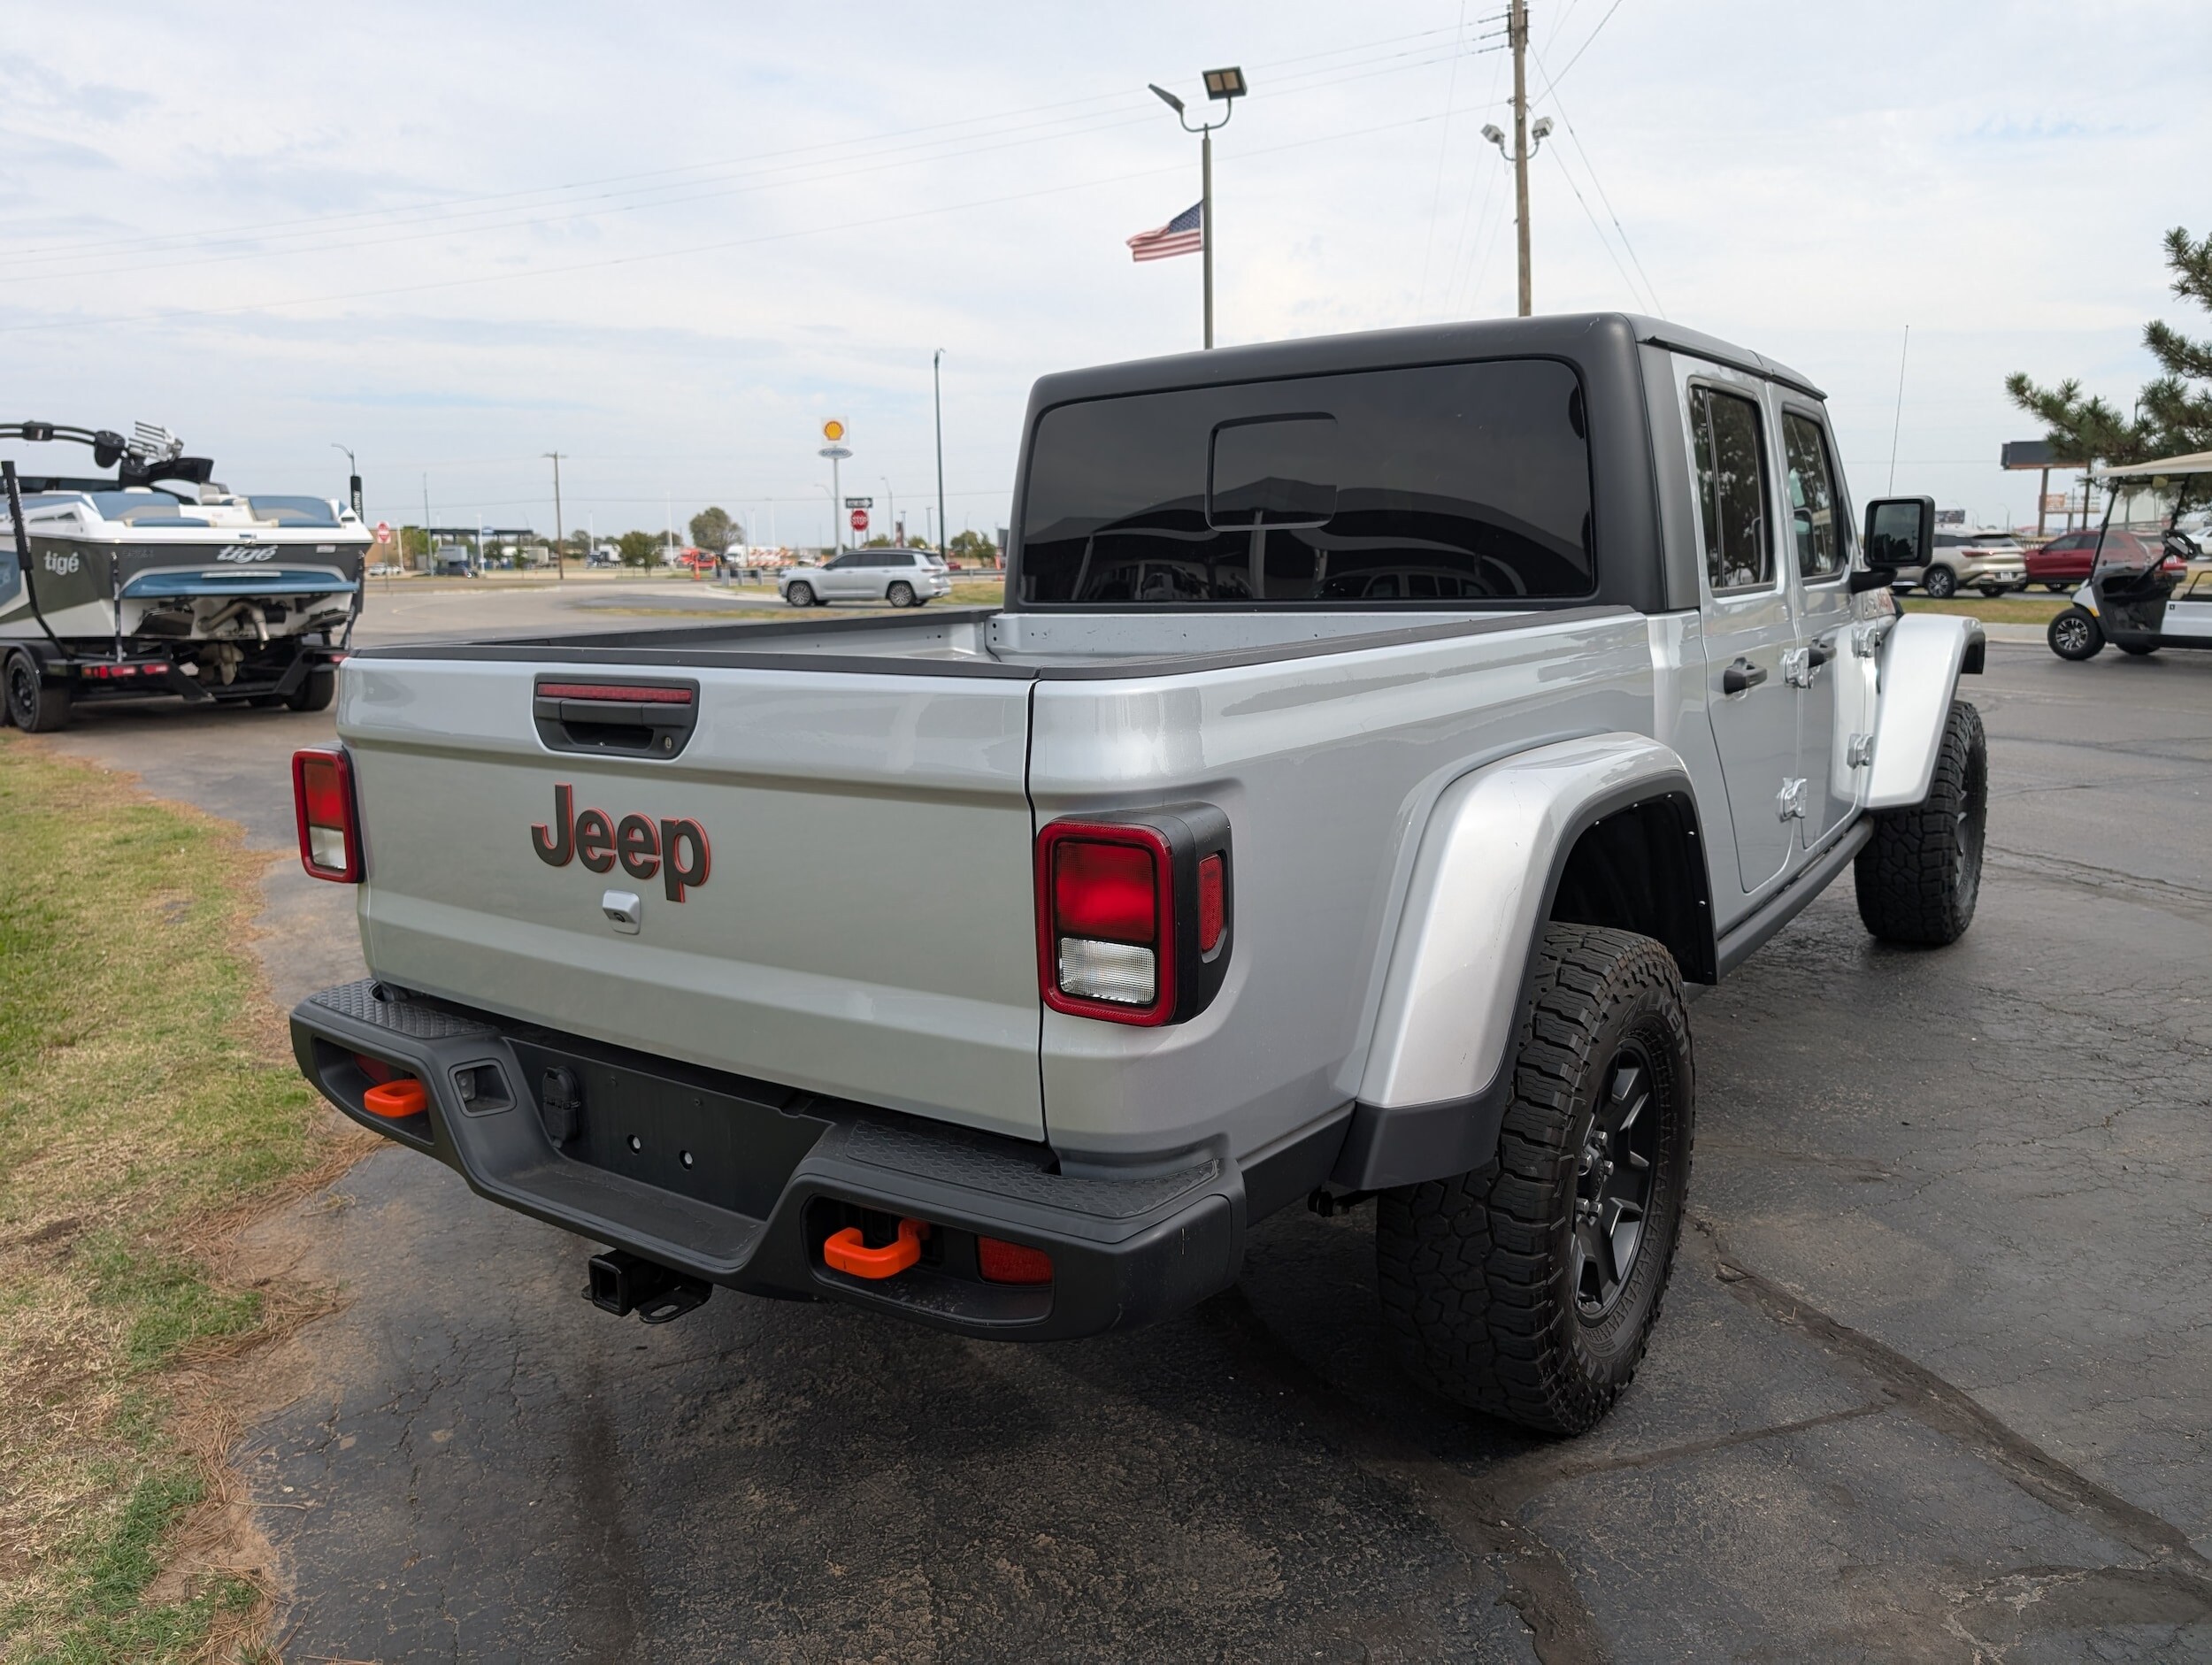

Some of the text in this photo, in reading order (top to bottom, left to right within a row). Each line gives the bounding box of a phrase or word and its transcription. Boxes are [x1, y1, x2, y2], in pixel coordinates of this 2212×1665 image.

[852, 516, 867, 526] STOP
[43, 550, 80, 576] tigé
[217, 544, 279, 564] tigé
[530, 781, 711, 904] Jeep
[1616, 990, 1688, 1057] FALKEN
